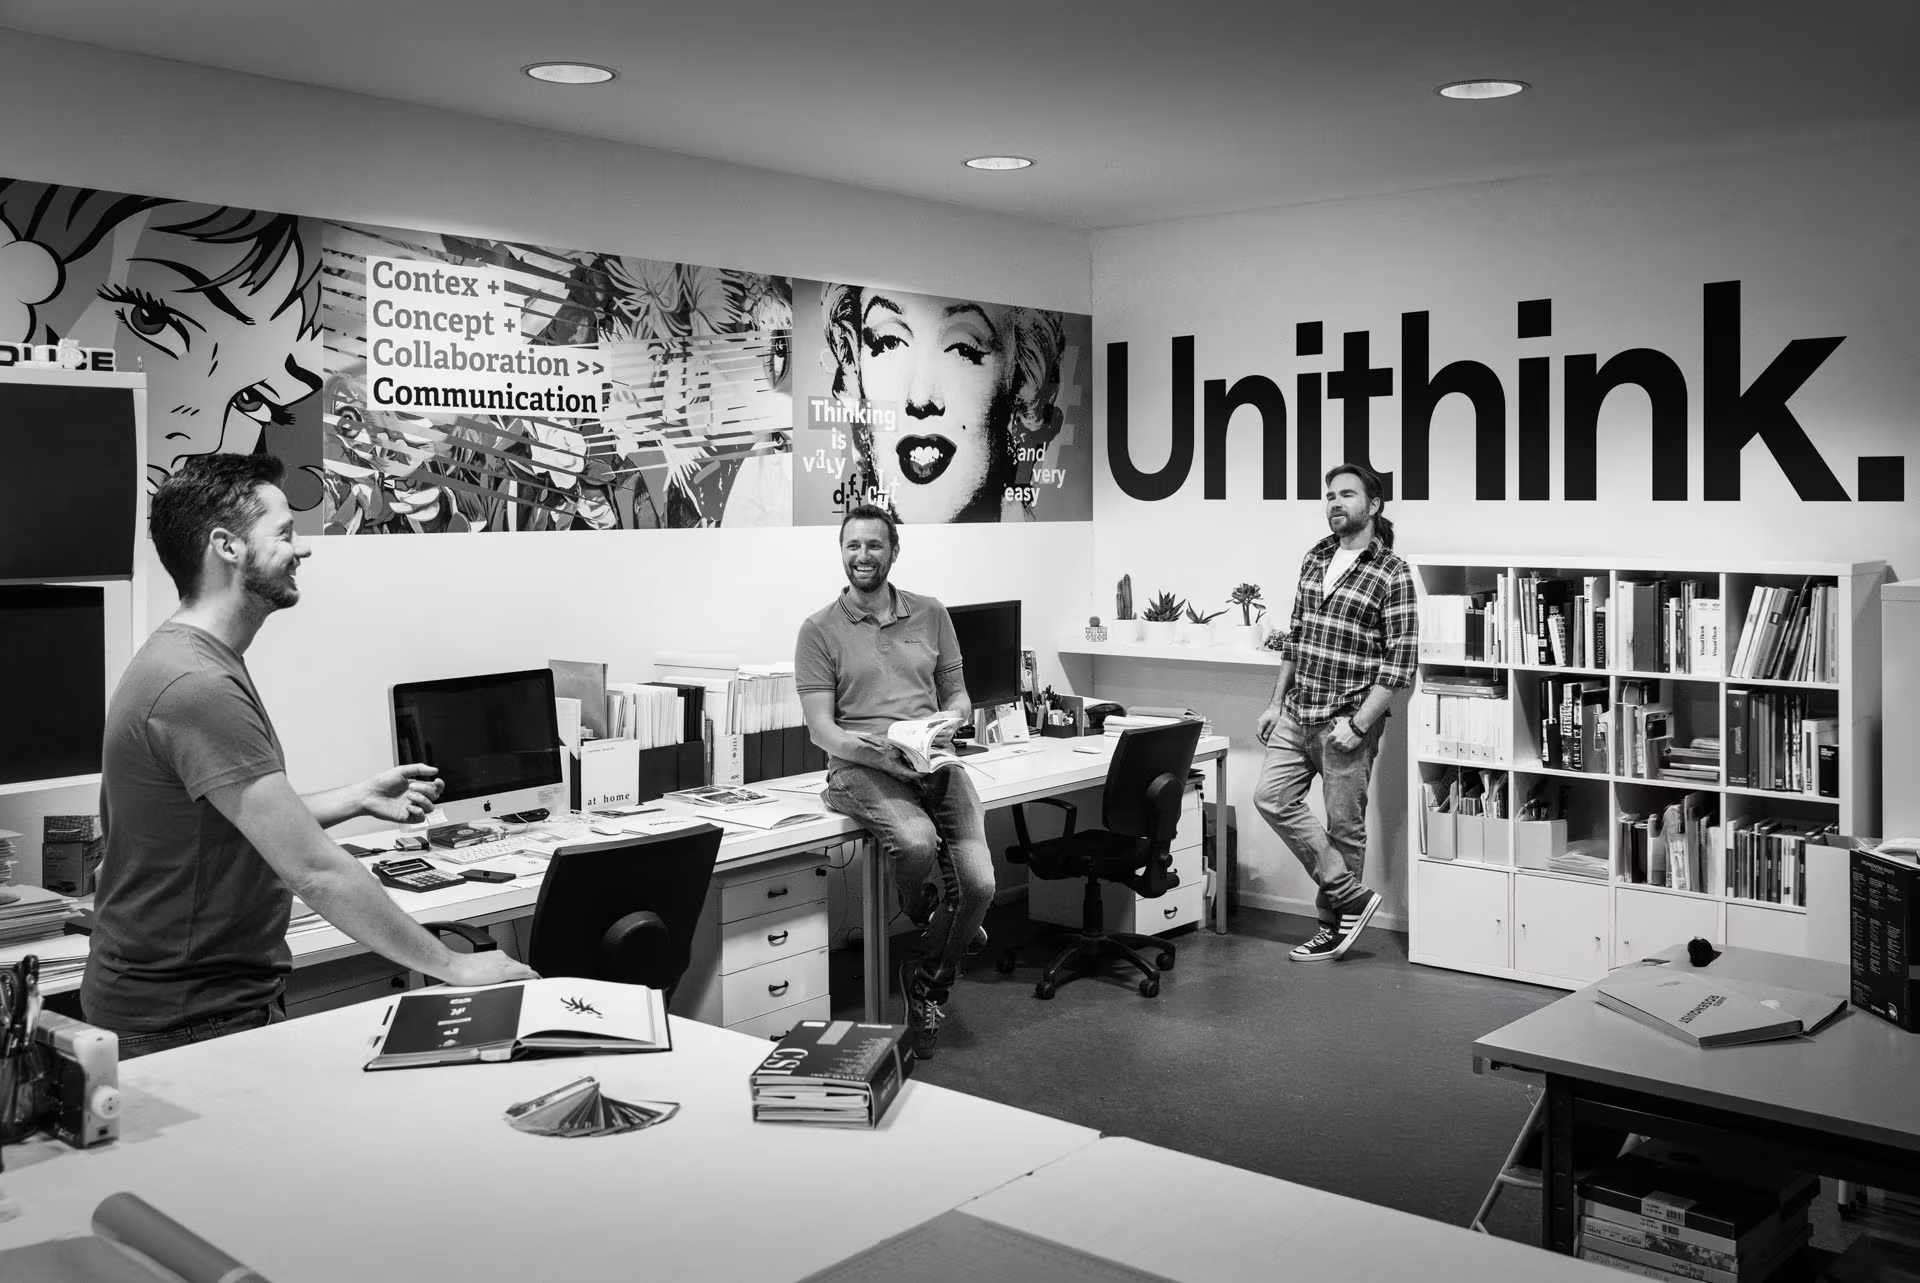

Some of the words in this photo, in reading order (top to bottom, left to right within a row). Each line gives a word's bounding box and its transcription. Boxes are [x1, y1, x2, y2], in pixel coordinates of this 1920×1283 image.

[372, 261, 480, 298] Contex
[487, 280, 500, 295] +
[372, 299, 495, 342] Concept
[503, 318, 516, 333] +
[372, 338, 570, 377] Collaboration
[372, 377, 598, 414] Communication
[1106, 279, 1905, 503] Unithink.
[811, 400, 896, 430] Thinking
[831, 428, 847, 450] is
[1017, 442, 1045, 462] and
[1032, 468, 1066, 488] very
[1004, 485, 1041, 508] easy
[1596, 623, 1605, 664] DISEGNUM
[587, 797, 597, 806] at
[603, 793, 630, 803] home
[755, 1047, 809, 1076] CSI
